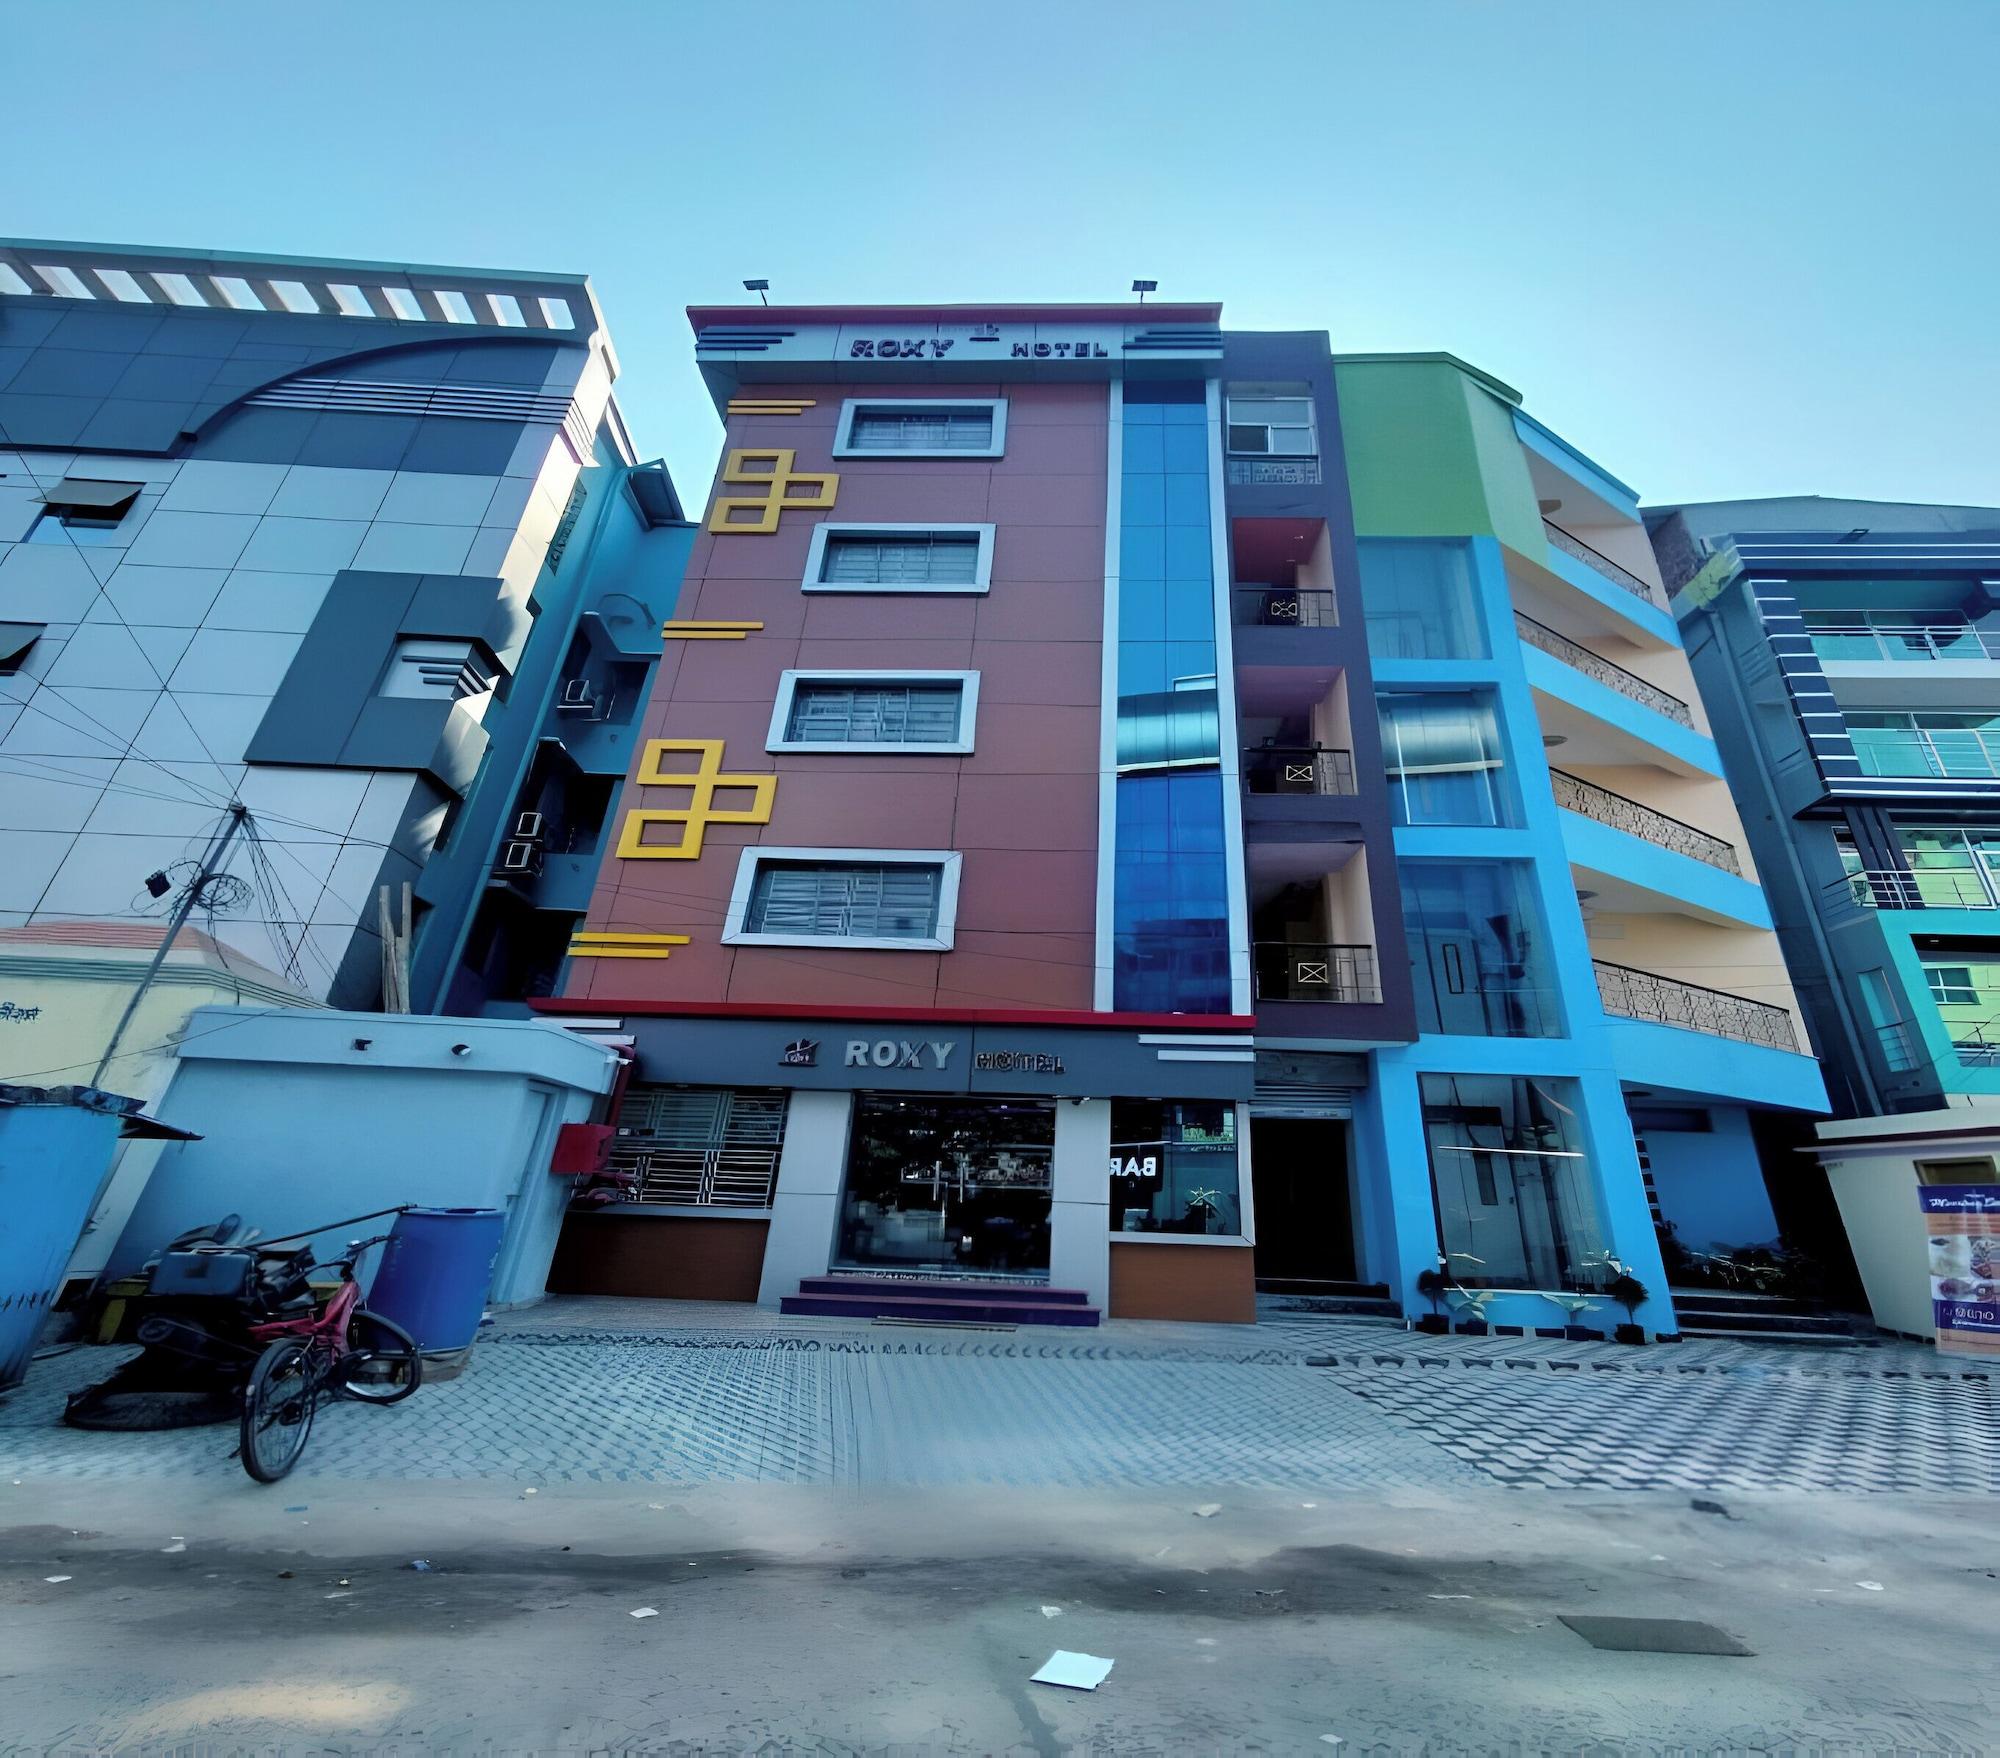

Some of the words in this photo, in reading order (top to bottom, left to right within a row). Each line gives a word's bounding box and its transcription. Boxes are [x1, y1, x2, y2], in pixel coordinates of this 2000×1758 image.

[850, 339, 955, 359] ROXY
[1010, 342, 1108, 358] HOTEL
[844, 1040, 957, 1070] ROXY
[975, 1050, 1066, 1074] HOTEL
